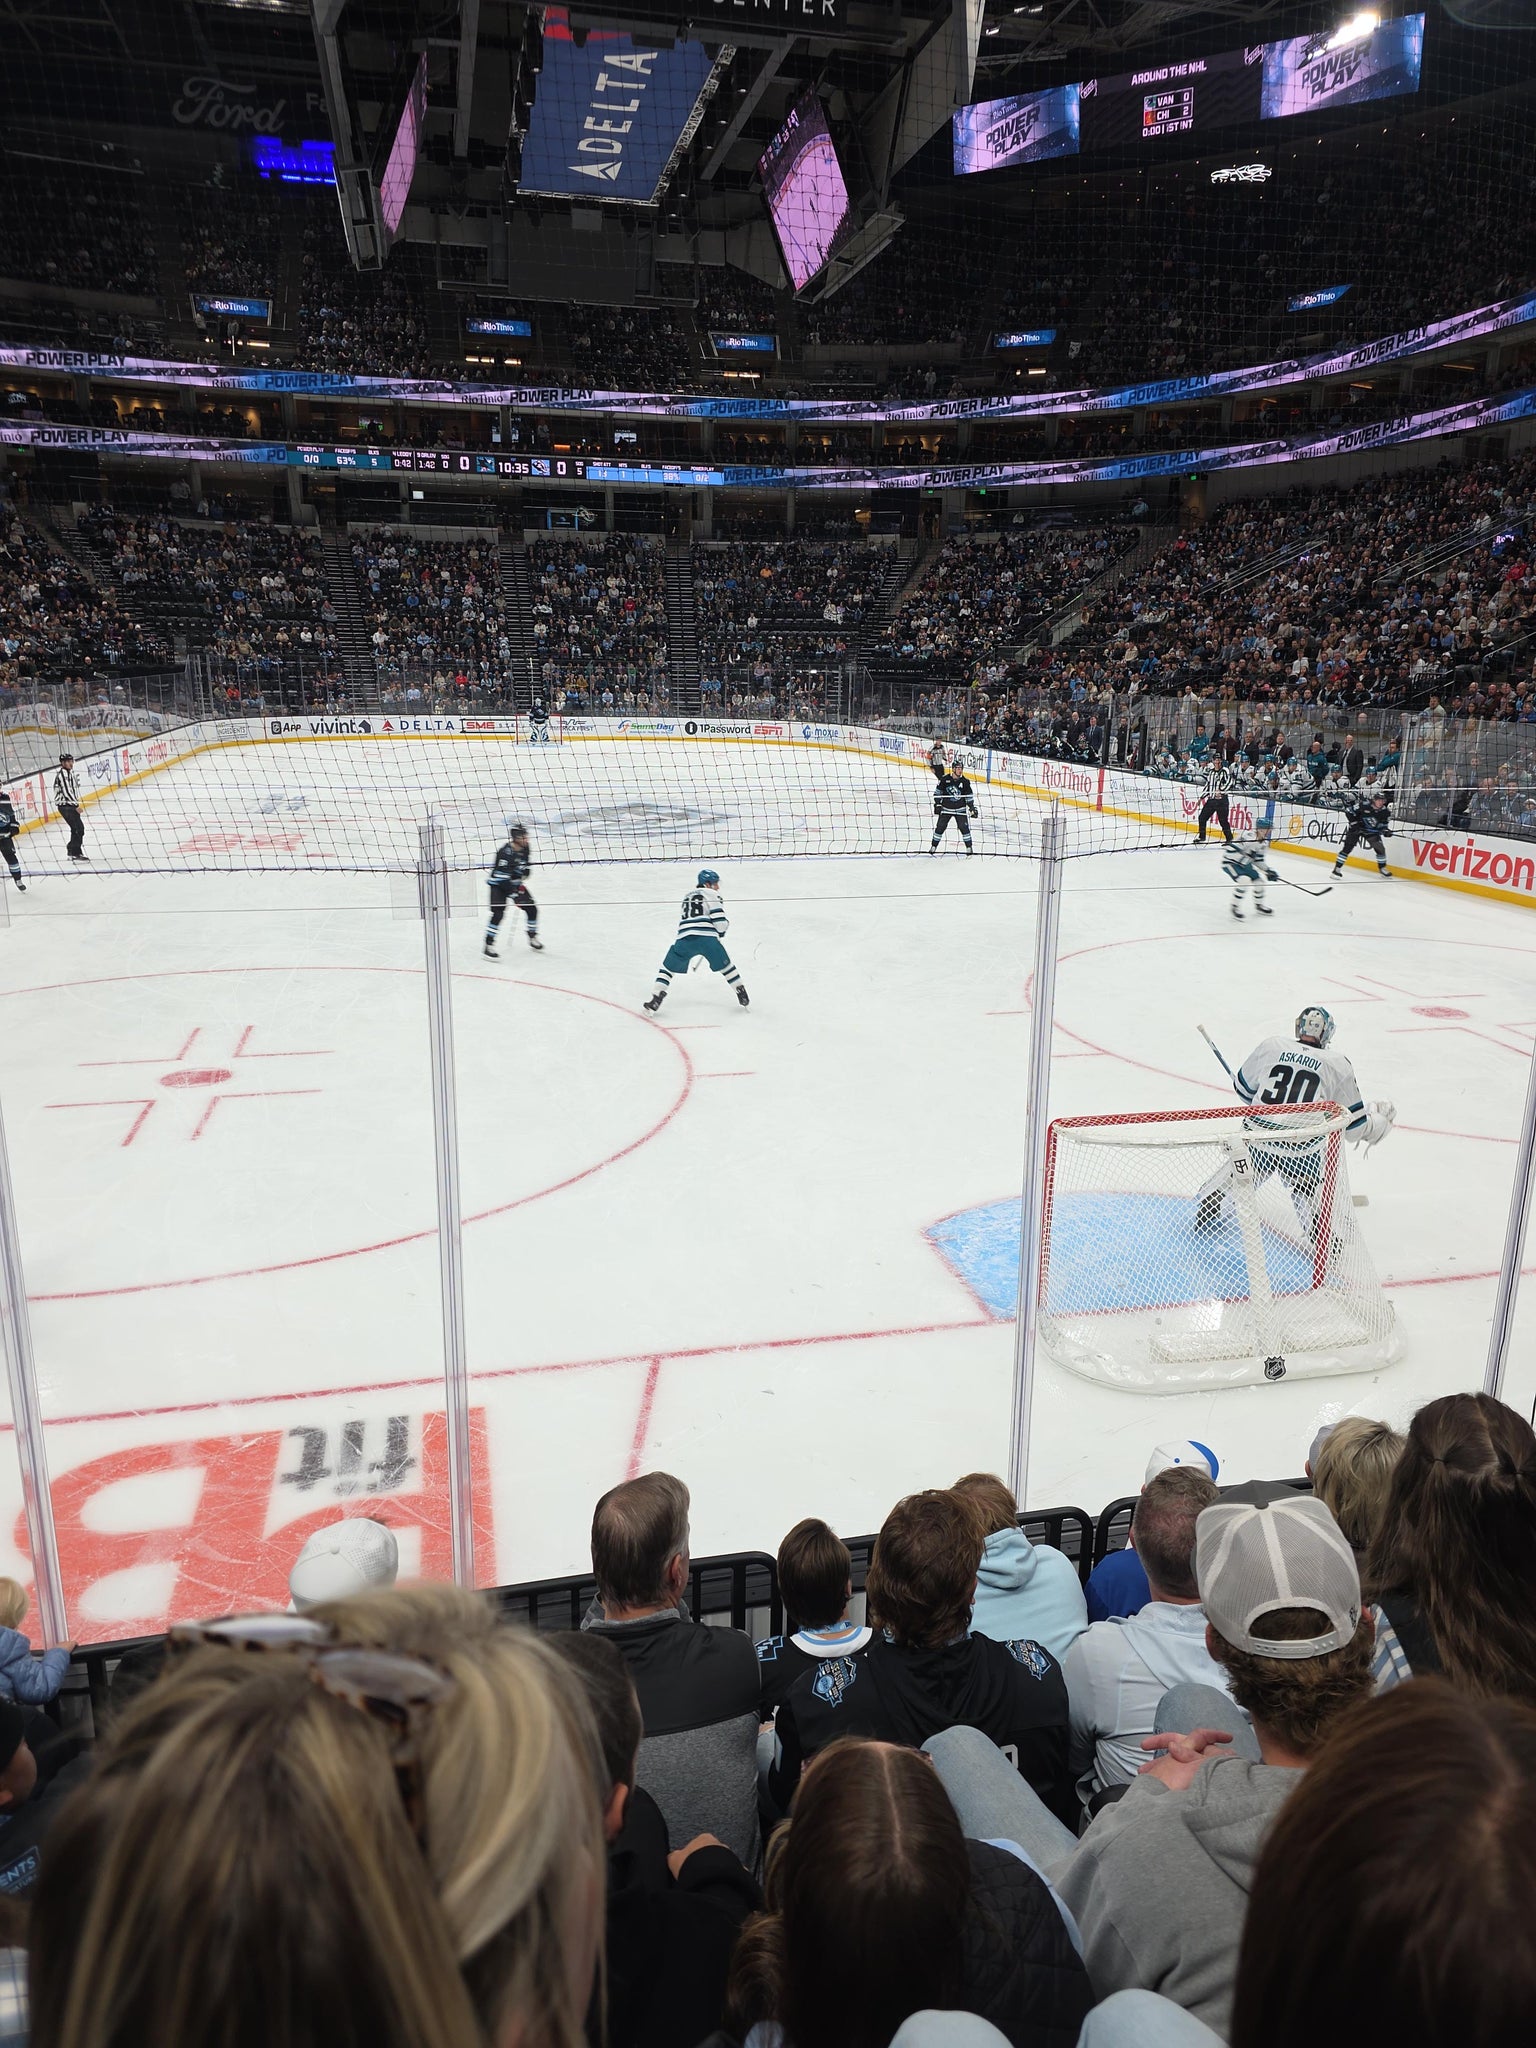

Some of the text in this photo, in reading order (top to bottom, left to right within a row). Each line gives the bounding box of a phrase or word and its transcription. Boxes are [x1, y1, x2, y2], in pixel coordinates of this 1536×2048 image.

[1301, 39, 1373, 89] POWER
[1131, 60, 1207, 86] AROUND THE NHL
[1311, 60, 1361, 99] PLAY
[172, 76, 287, 133] Ford
[577, 52, 658, 154] DELTA
[1156, 92, 1190, 107] VAN 0
[1156, 106, 1189, 121] CHI 2
[986, 106, 1040, 149] POWER
[995, 125, 1033, 158] PLAY
[1304, 291, 1336, 305] RioTinto
[215, 301, 249, 312] RioTinto
[483, 322, 514, 332] RioTinto
[1010, 334, 1040, 344] RioTinto
[1350, 326, 1428, 367] POWER PLAY
[26, 352, 84, 366] POWER
[88, 354, 126, 367] PLAY
[1304, 361, 1344, 380] RioTinto
[212, 378, 258, 389] RioTinto
[265, 375, 355, 388] POWER PLAY
[509, 388, 593, 403] POWER PLAY
[1127, 375, 1212, 404] POWER PLAY
[461, 394, 504, 405] RioTinto
[1081, 397, 1123, 411] RioTinto
[665, 405, 703, 416] RioTinto
[709, 399, 790, 415] POWER PLAY
[930, 396, 1013, 418] POWER PLAY
[885, 409, 925, 421] RioTinto
[30, 430, 130, 443] POWER PLAY
[1337, 415, 1414, 450] POWER PLAY
[215, 450, 260, 461] RioTinto
[304, 454, 320, 464] 0/0
[1291, 443, 1331, 461] RioTinto
[336, 456, 356, 465] 63%
[371, 458, 378, 467] 5
[394, 459, 411, 468] 0:42
[419, 460, 435, 469] 1:42
[442, 460, 448, 469] 0
[460, 456, 469, 470] 0
[1119, 450, 1201, 476] POWER PLAY
[499, 462, 529, 474] 10:35
[556, 461, 566, 475] 0
[577, 467, 583, 475] 5
[755, 467, 785, 479] PLAY
[924, 465, 1005, 485] POWER PLAY
[1073, 470, 1114, 482] RioTinto
[310, 718, 356, 734] vivint
[400, 720, 455, 730] DELTA
[466, 721, 495, 729] SME
[630, 722, 675, 732] SameDay
[700, 724, 751, 734] 1Password
[754, 725, 783, 735] ESPN
[814, 728, 839, 737] moxie
[1042, 762, 1092, 793] RioTinto
[1412, 838, 1535, 891] verizon
[681, 894, 704, 920] 38
[1278, 1051, 1322, 1071] ASKAROV
[1260, 1064, 1320, 1104] 30
